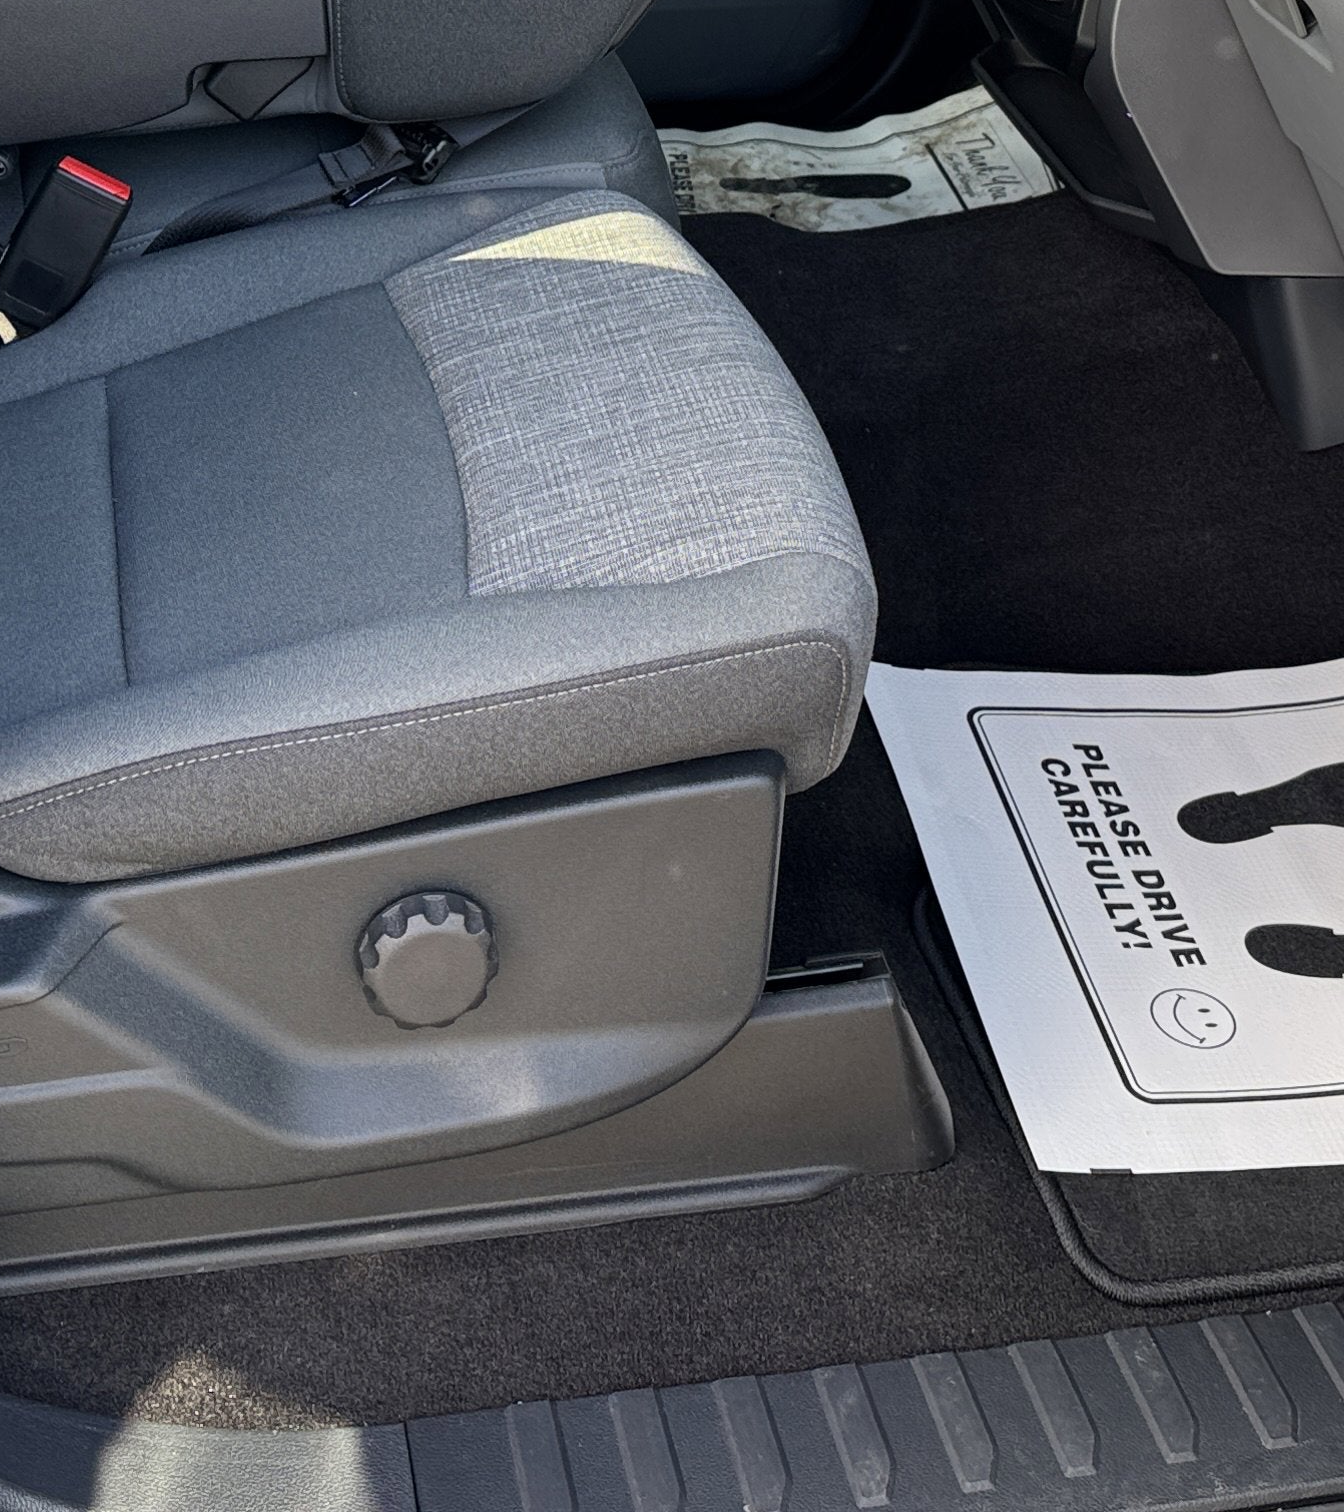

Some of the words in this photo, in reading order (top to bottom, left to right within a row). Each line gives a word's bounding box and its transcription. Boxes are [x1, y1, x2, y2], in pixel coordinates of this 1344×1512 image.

[981, 175, 1022, 201] You
[1041, 757, 1154, 949] CAREFULLY!
[1072, 744, 1153, 858] PLEASE
[1131, 869, 1207, 967] DRIVE
